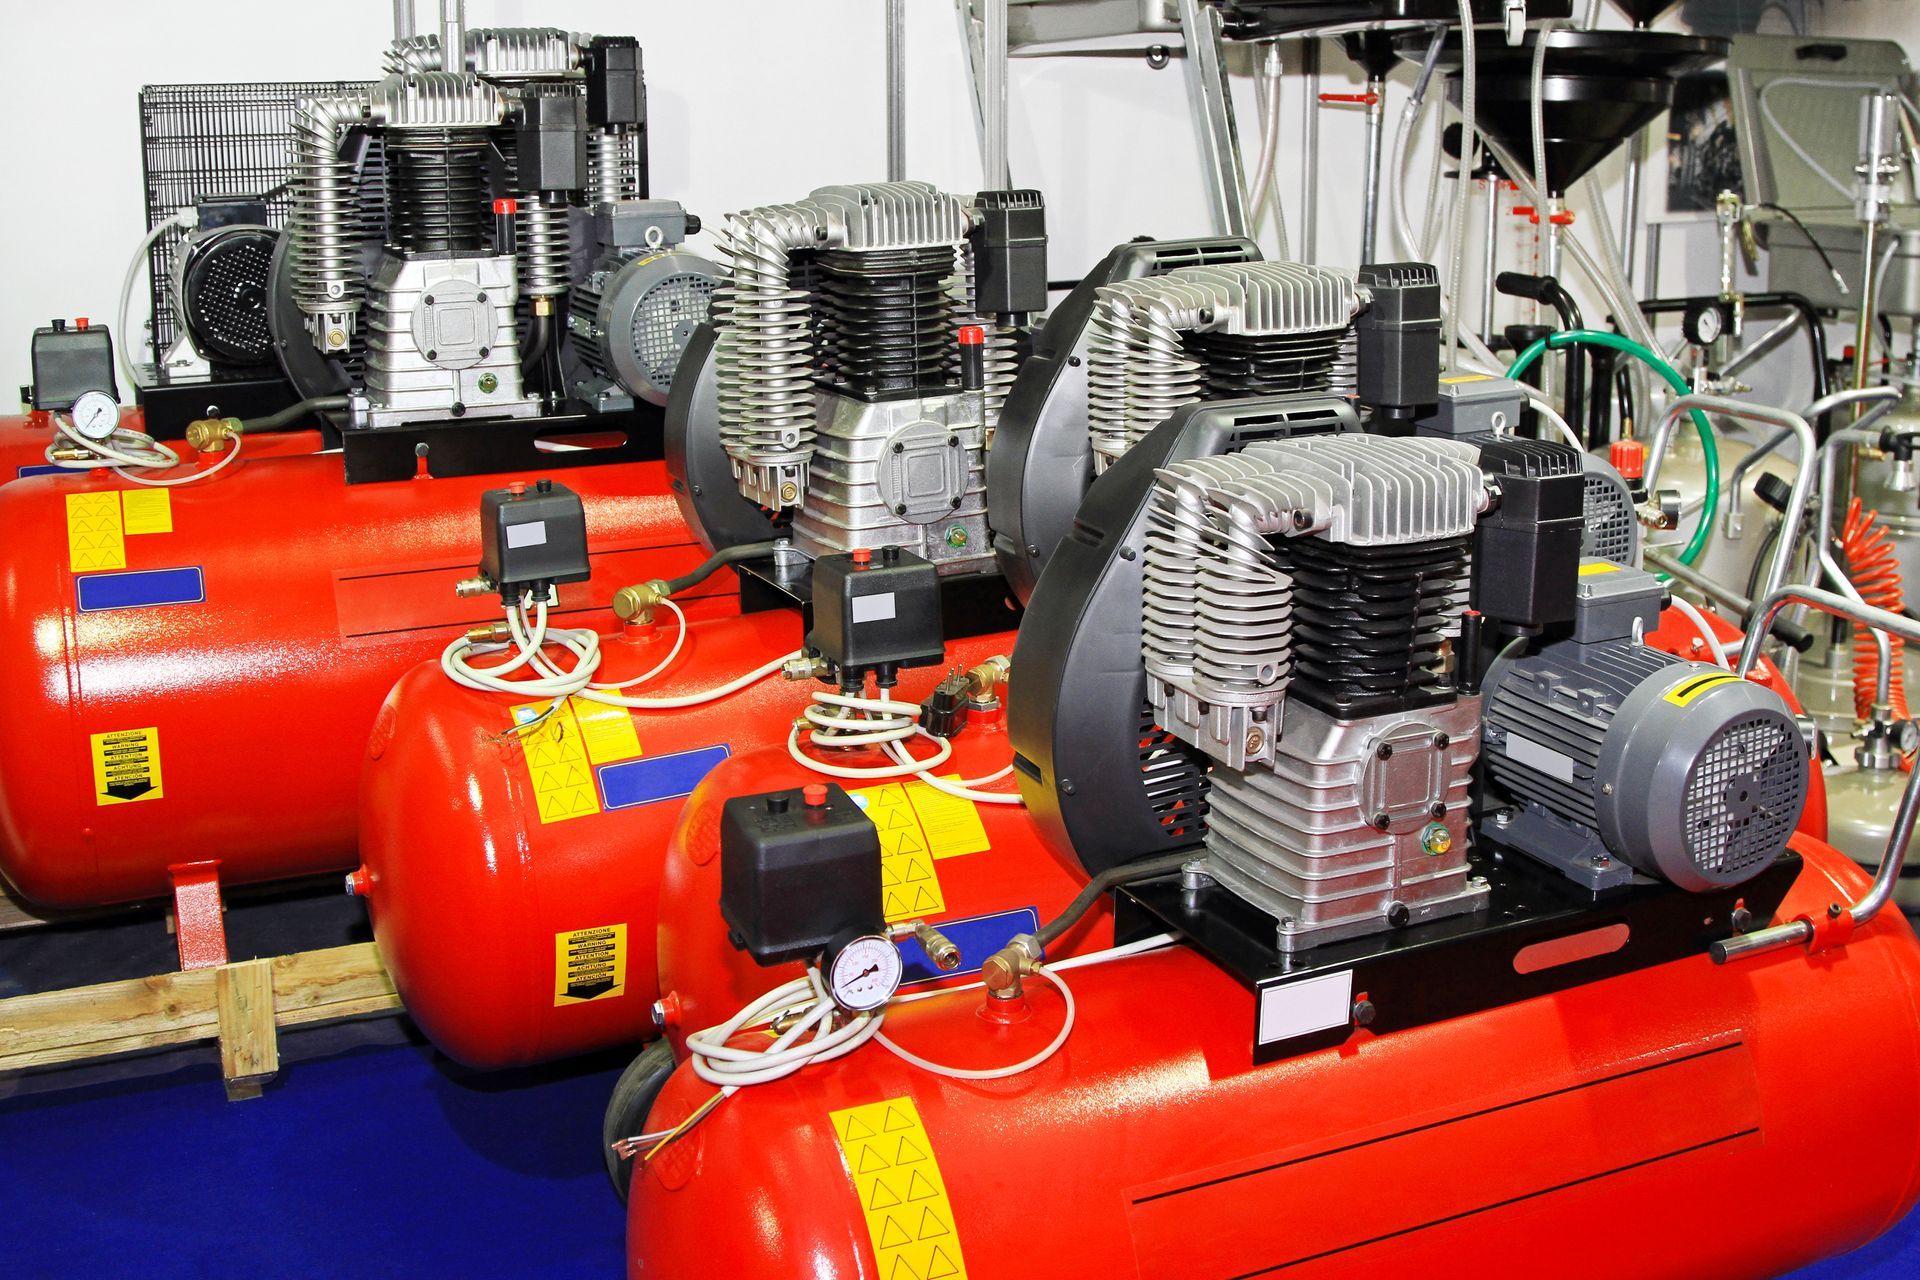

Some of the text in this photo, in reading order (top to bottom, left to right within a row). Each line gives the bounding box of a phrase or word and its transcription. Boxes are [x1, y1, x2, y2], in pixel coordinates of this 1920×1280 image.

[573, 928, 610, 937] ATTENZIONE
[578, 940, 606, 948] WARNING
[575, 951, 608, 960] ATTENTION
[577, 962, 606, 971] ACHTUNG
